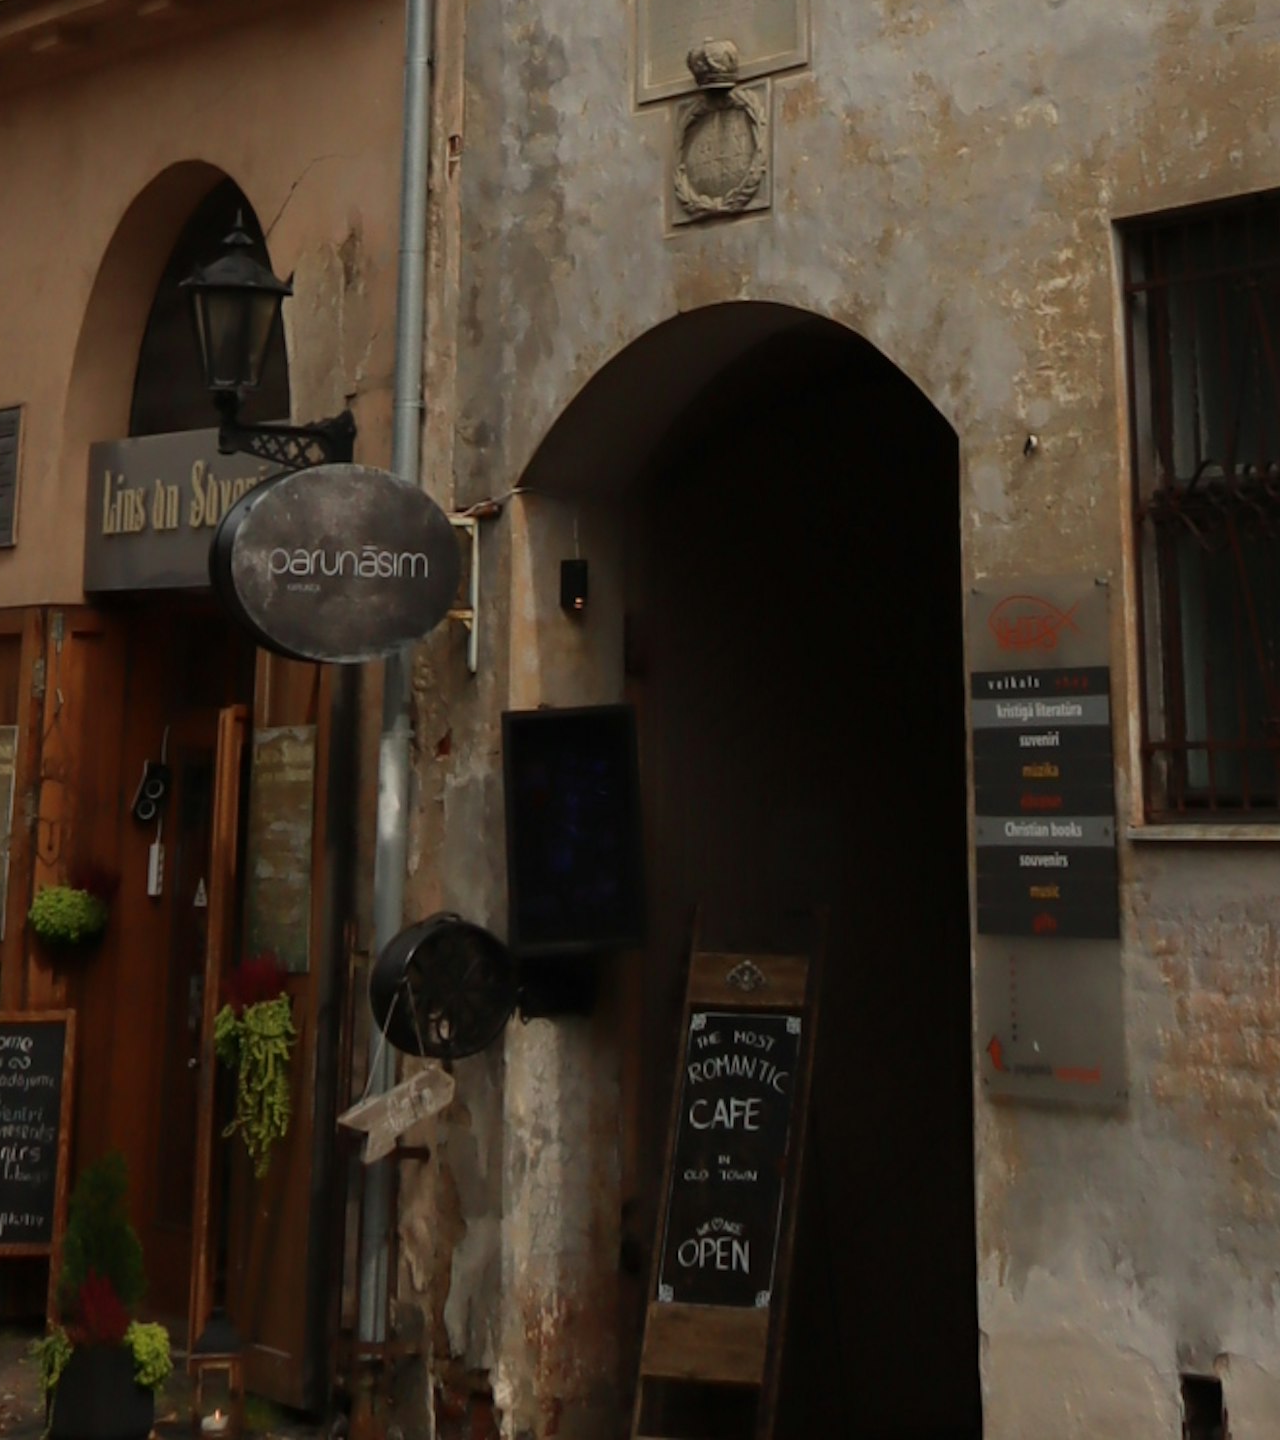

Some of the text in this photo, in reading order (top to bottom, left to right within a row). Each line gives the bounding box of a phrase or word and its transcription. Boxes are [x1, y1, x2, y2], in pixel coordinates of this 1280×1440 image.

[268, 545, 429, 579] parunāsim
[1004, 821, 1082, 837] Christian books
[1019, 851, 1070, 868] souvenirs
[733, 1029, 776, 1053] MOST
[687, 1052, 791, 1095] ROMANTIC
[689, 1095, 763, 1131] CAFE
[718, 1154, 731, 1165] IN
[683, 1167, 758, 1182] OLD TOWN
[677, 1235, 750, 1275] OPEN
